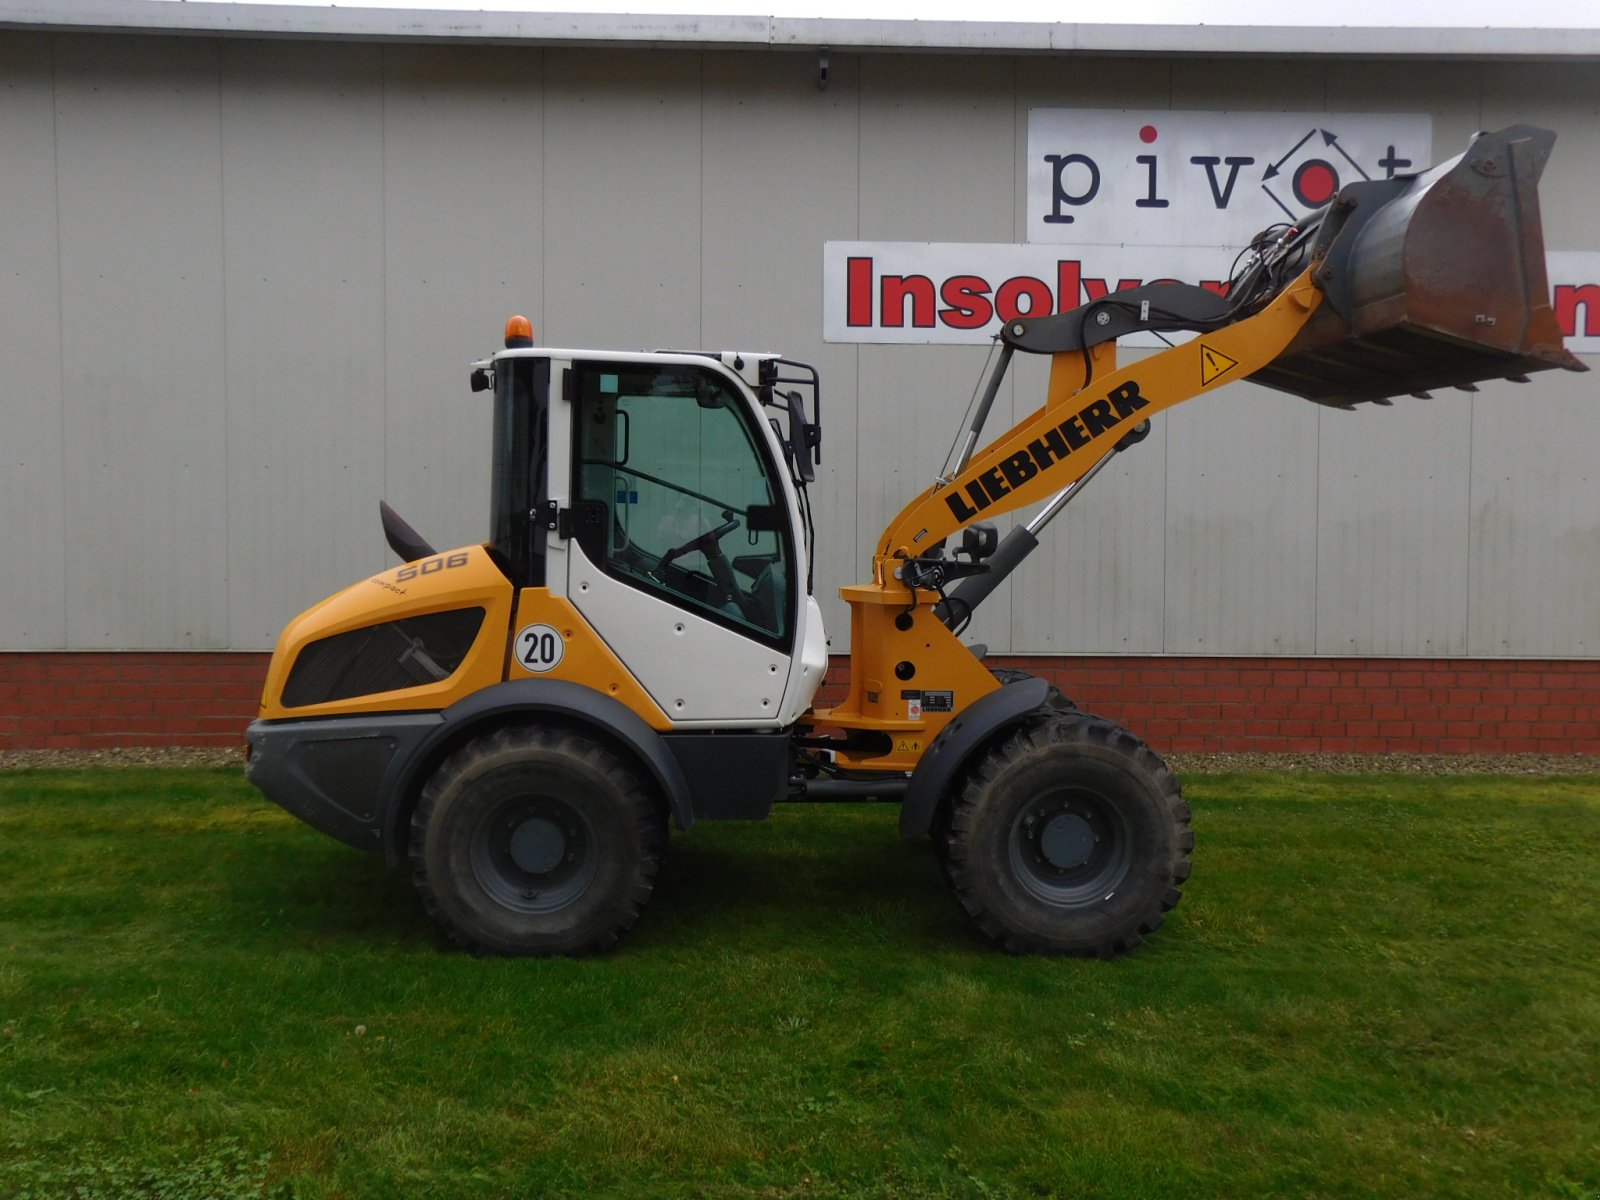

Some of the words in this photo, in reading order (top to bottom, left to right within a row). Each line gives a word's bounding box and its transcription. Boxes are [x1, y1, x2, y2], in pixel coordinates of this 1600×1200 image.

[944, 380, 1150, 524] LIEBHERR
[396, 552, 468, 583] 506
[524, 632, 555, 664] 20
